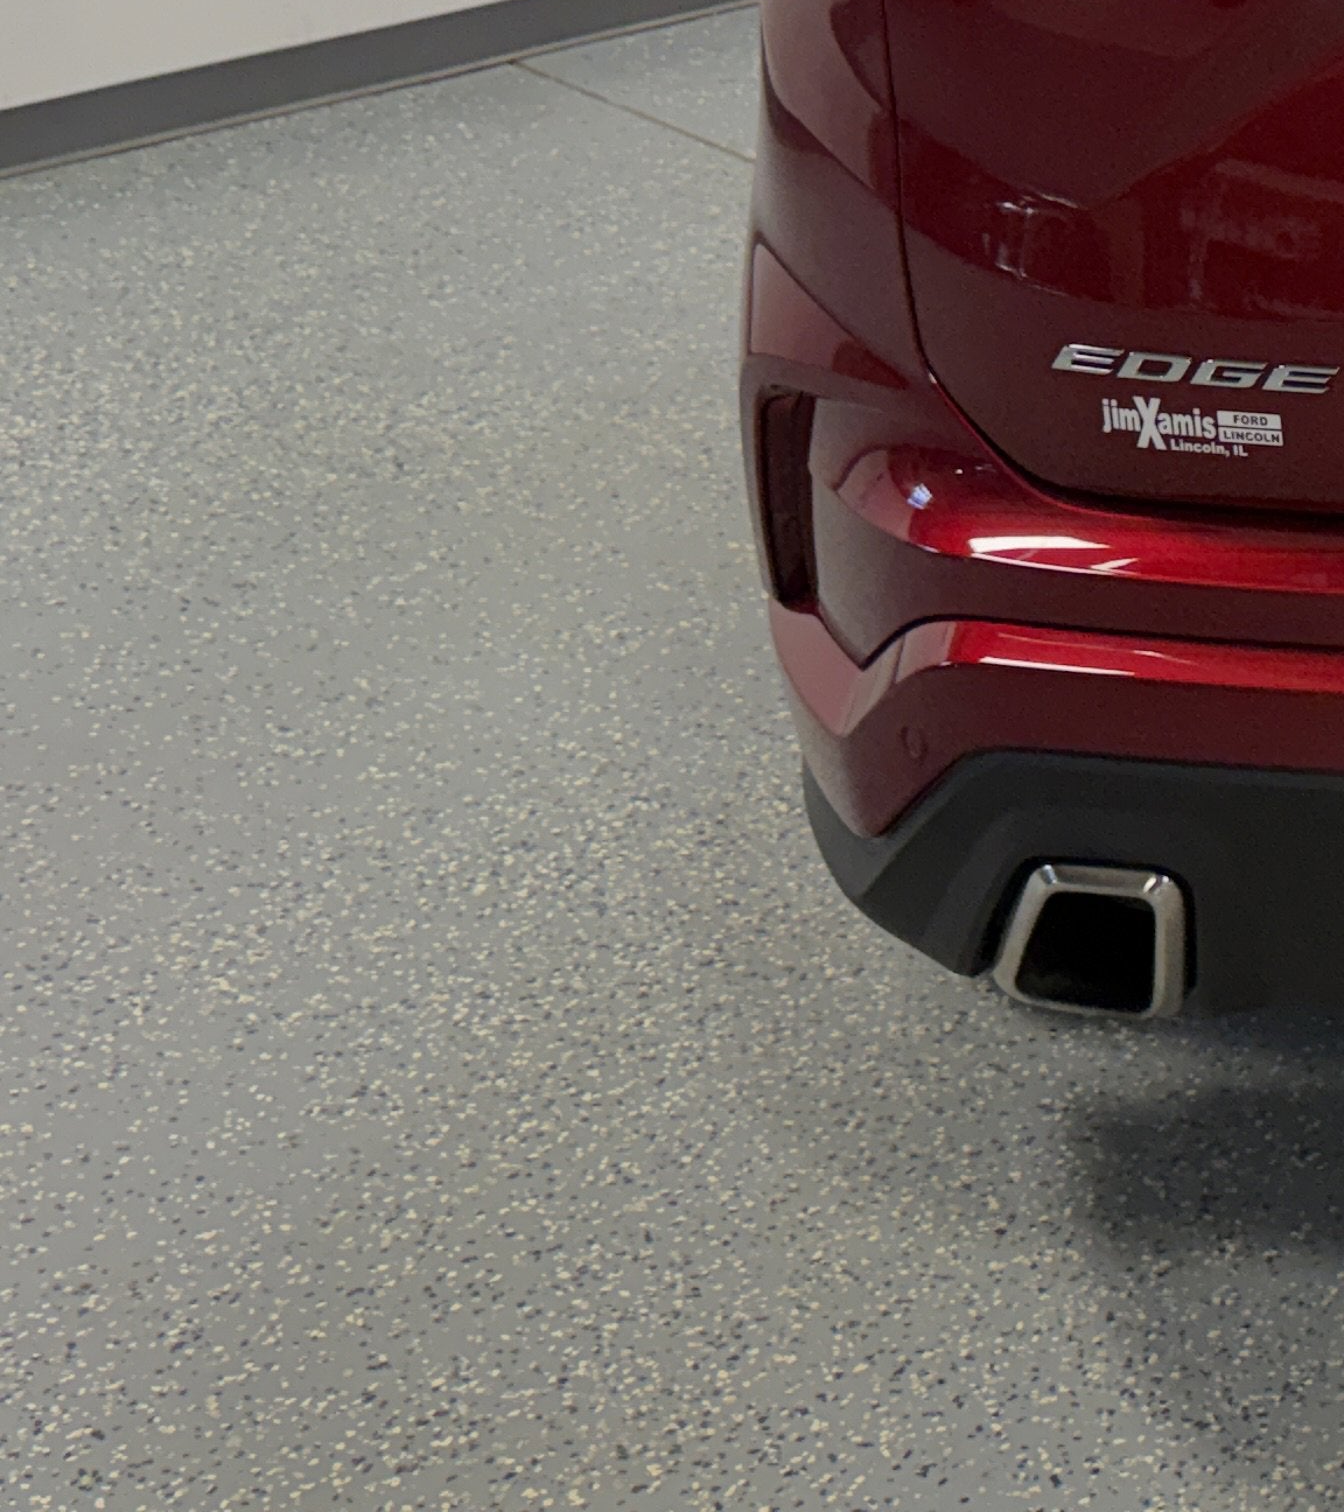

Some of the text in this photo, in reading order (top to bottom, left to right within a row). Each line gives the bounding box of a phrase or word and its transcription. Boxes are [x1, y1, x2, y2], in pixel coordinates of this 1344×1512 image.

[1052, 343, 1340, 394] EDGE
[1233, 414, 1268, 426] FORD
[1223, 430, 1280, 443] LINCOLN
[1170, 439, 1248, 458] Lincoln, IL
